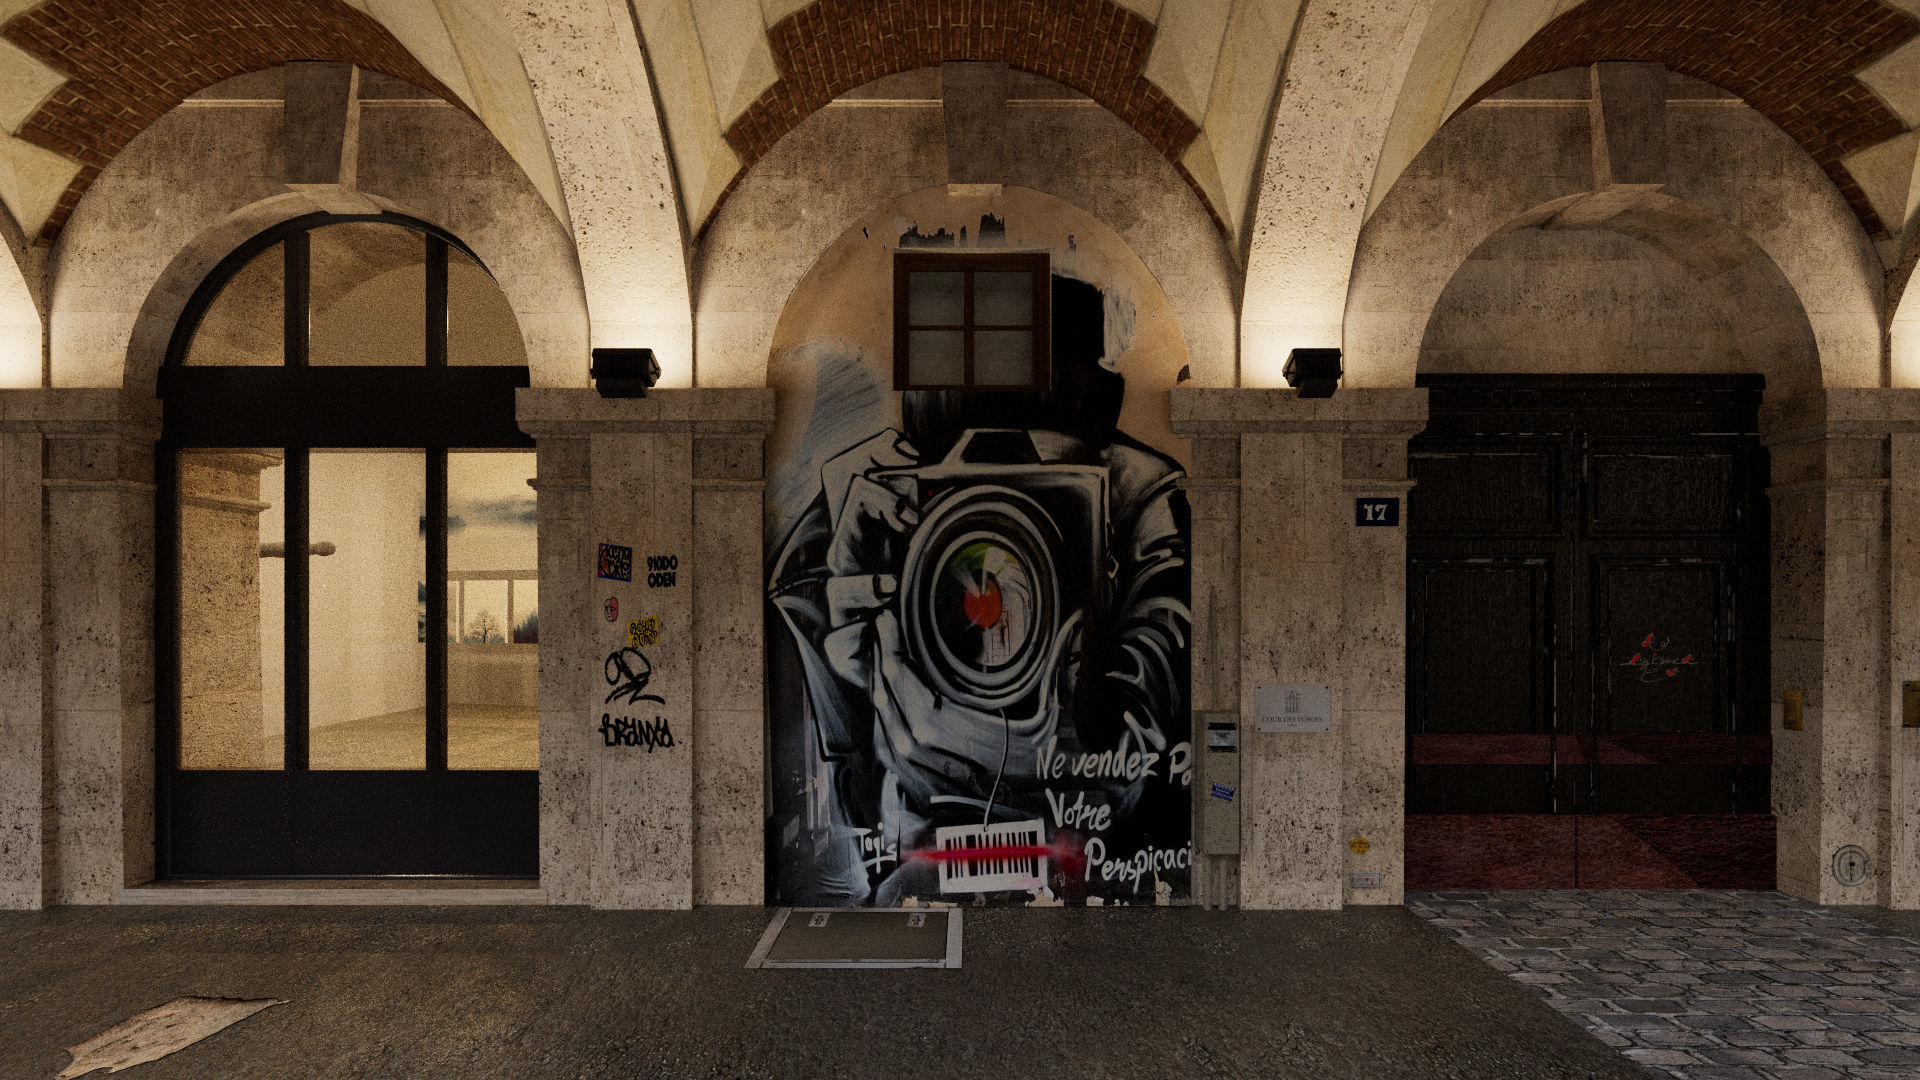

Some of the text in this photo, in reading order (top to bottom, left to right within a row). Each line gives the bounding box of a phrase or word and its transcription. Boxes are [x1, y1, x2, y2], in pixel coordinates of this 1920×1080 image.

[1364, 503, 1388, 521] 17
[1036, 734, 1067, 781] Ne
[1071, 730, 1160, 782] vendez
[1044, 787, 1112, 832] Votre
